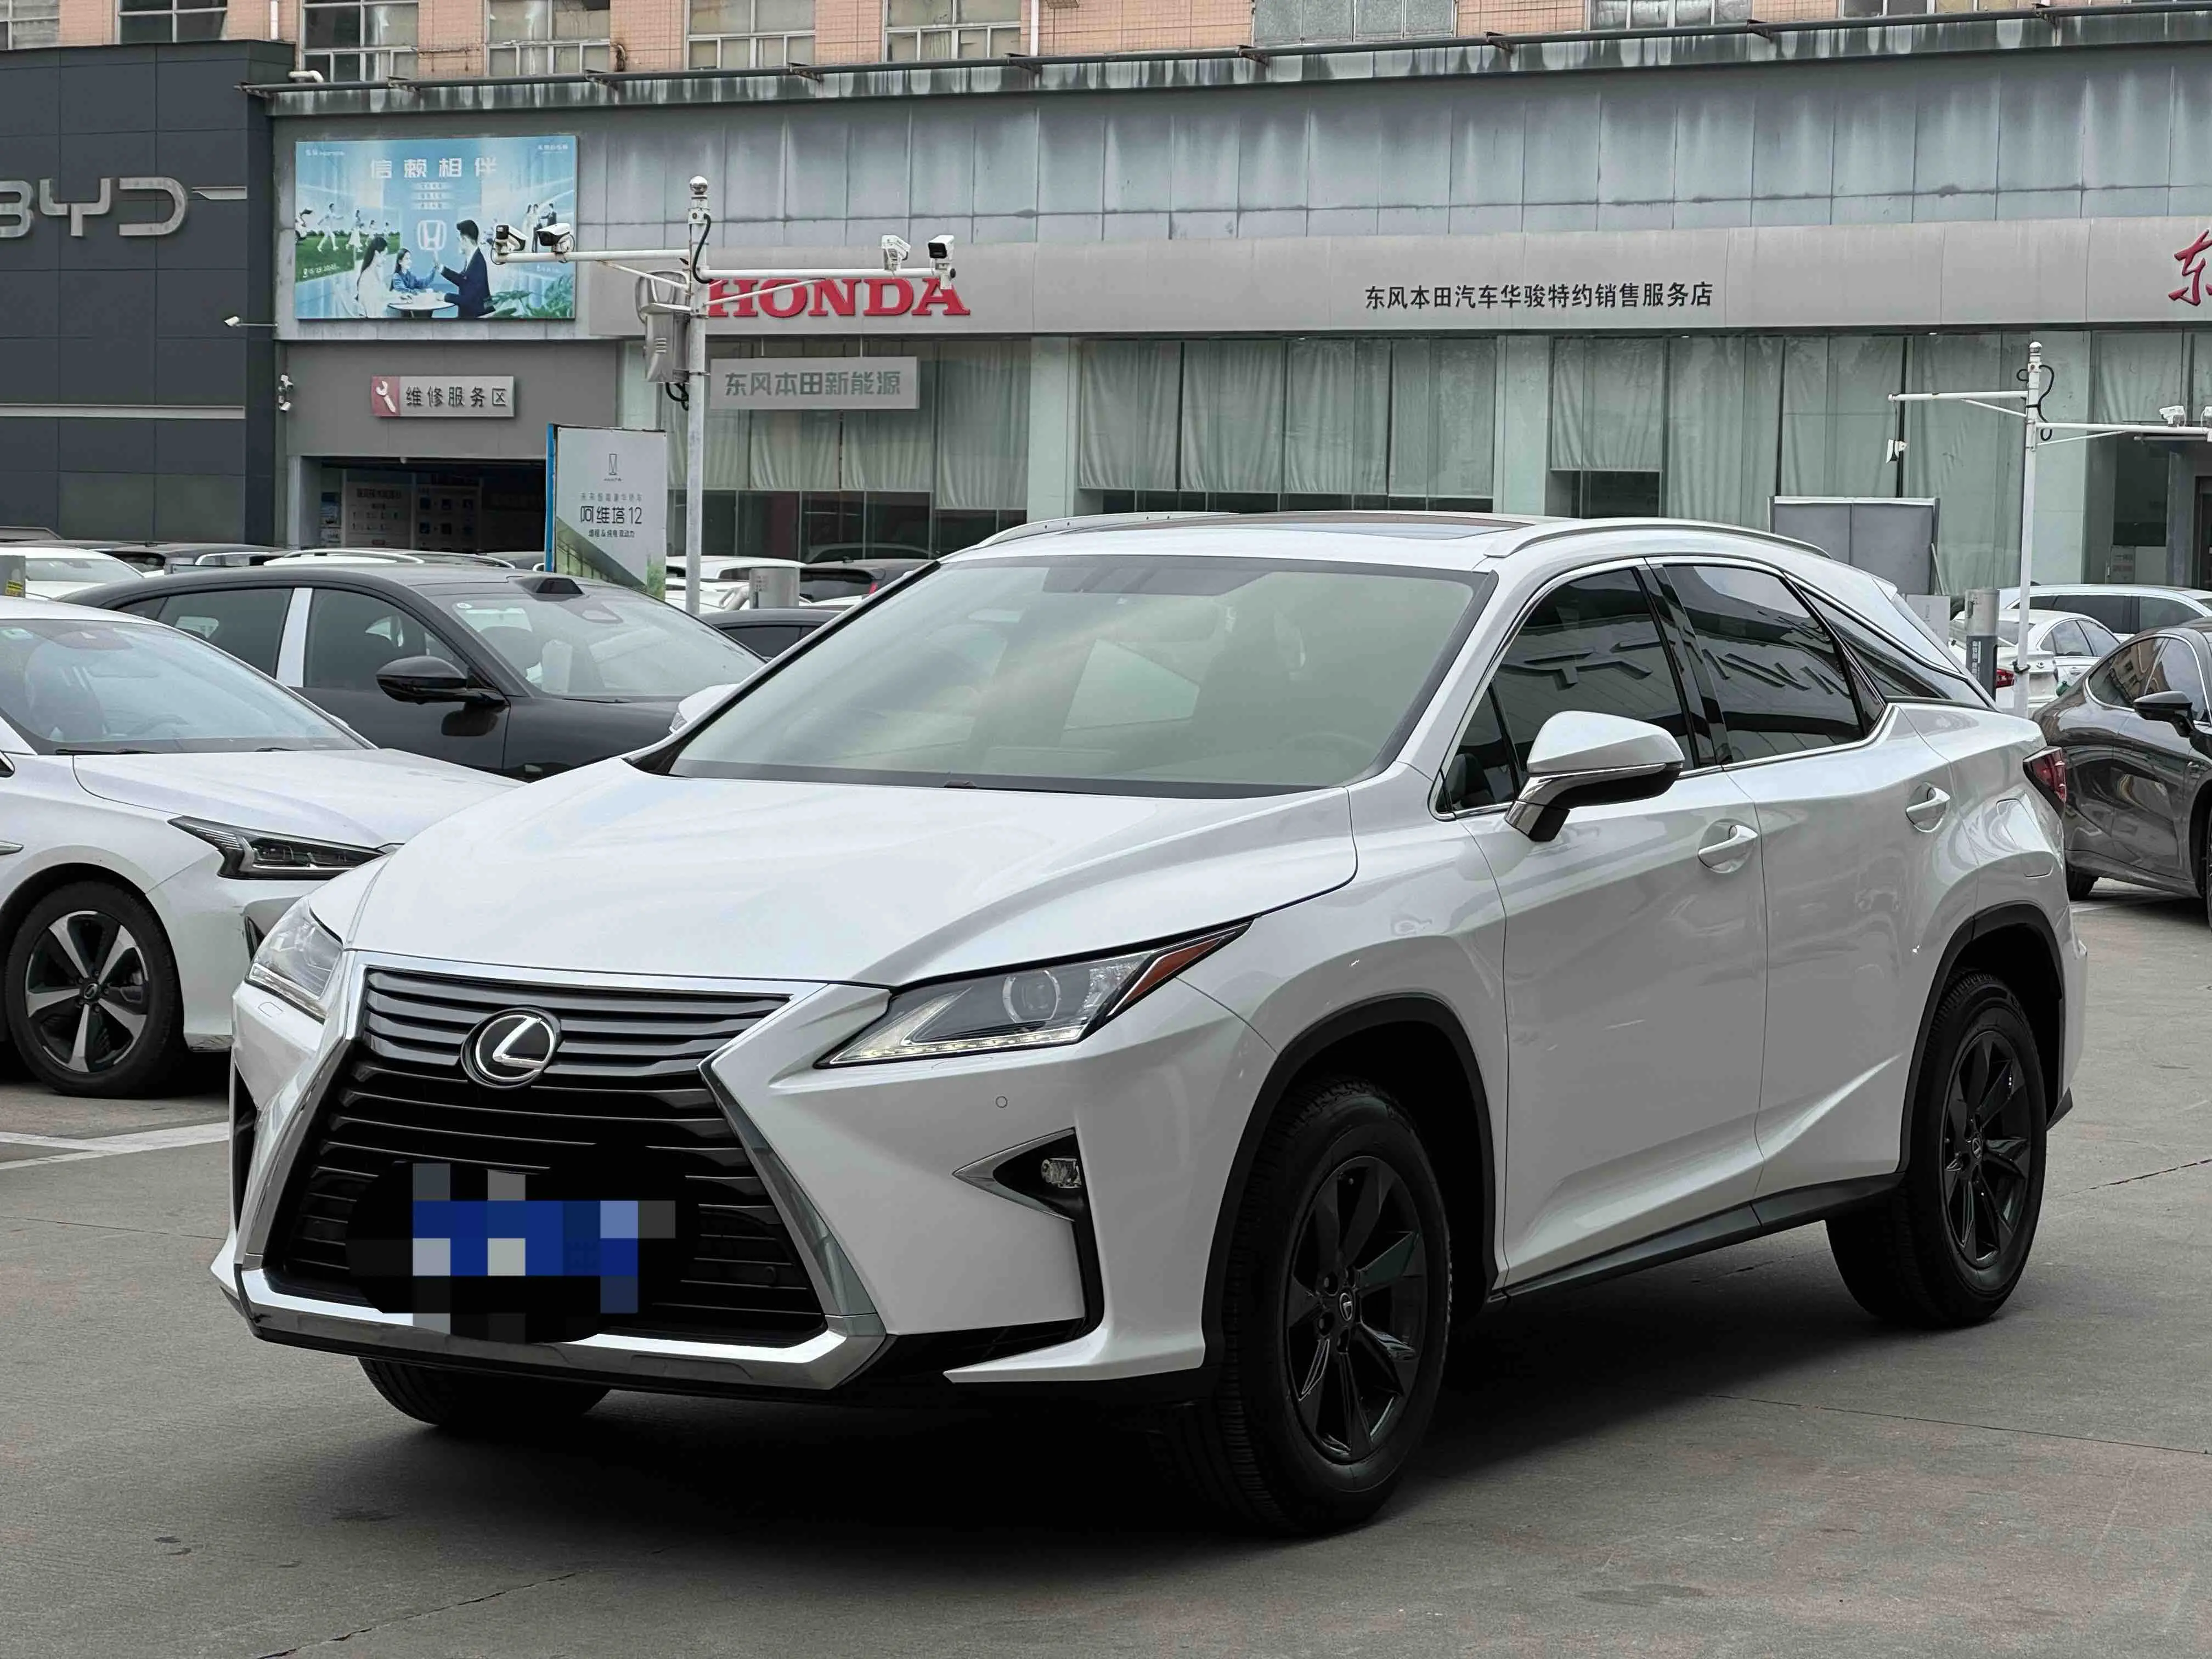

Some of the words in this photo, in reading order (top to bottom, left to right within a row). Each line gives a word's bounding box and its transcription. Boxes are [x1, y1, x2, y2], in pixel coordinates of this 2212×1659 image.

[370, 157, 497, 179] 信赖相伴
[708, 277, 971, 318] HONDA
[1364, 281, 1714, 310] 东风本田汽车华骏特约销售服务店
[725, 371, 901, 396] 东风本田新能源
[405, 386, 507, 408] 维修服务区
[580, 505, 642, 524] 阿维塔12
